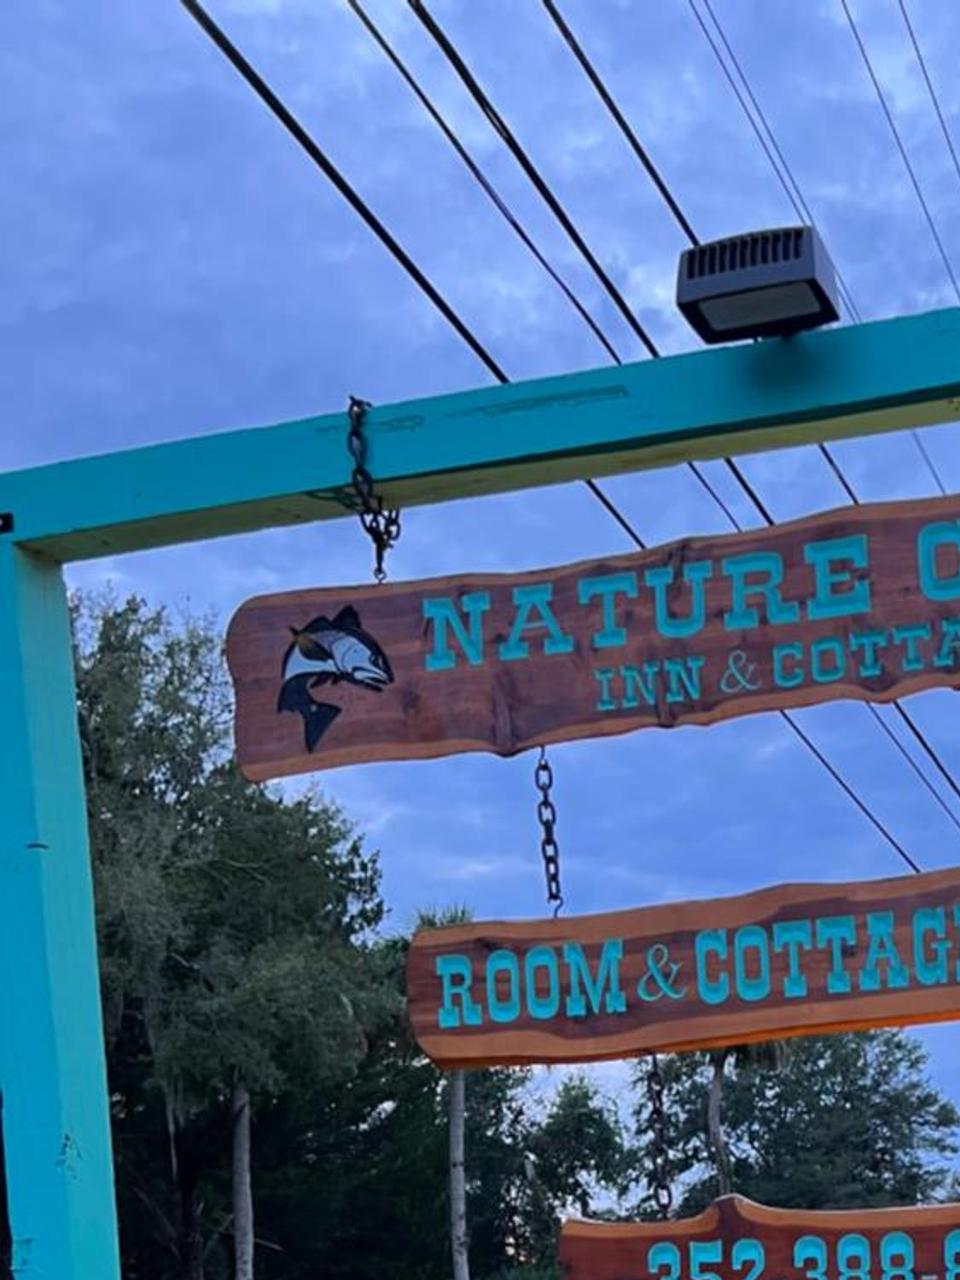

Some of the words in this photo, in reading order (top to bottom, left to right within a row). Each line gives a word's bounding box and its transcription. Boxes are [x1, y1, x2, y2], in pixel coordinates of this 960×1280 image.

[421, 533, 871, 671] NATURE
[594, 656, 704, 713] INN
[719, 649, 761, 693] &
[435, 938, 627, 1029] ROOM
[637, 943, 687, 1001] &
